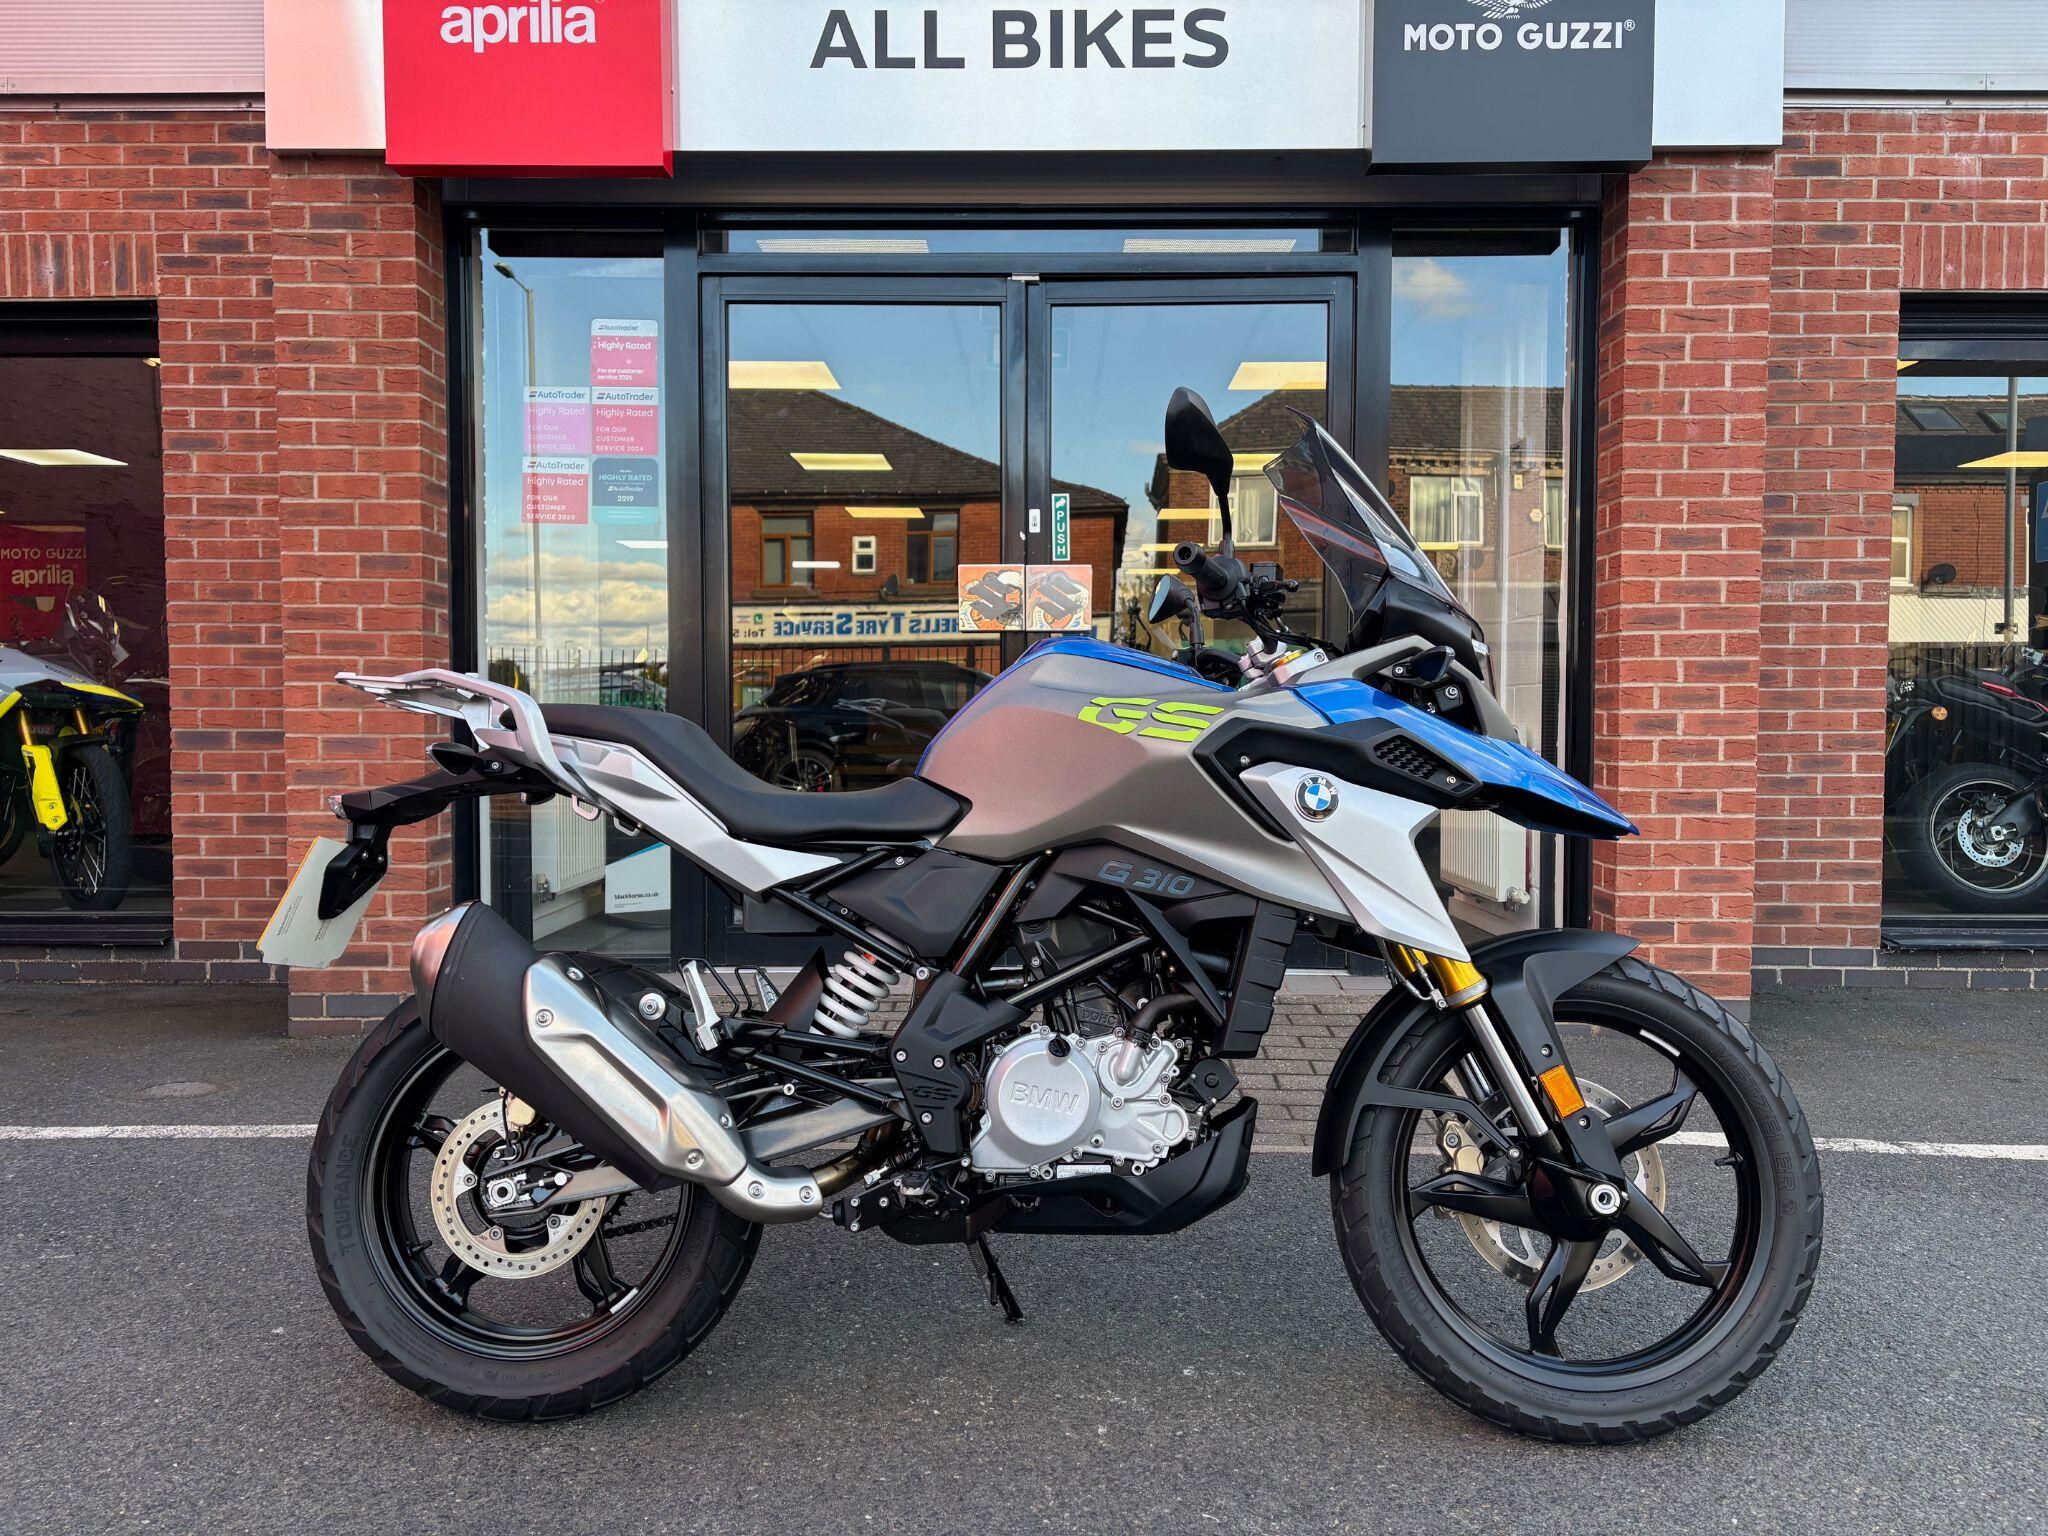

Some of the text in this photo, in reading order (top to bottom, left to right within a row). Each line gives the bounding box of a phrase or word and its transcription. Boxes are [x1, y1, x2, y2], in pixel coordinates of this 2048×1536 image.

[440, 0, 596, 53] aprilia
[810, 8, 1229, 69] ALL BIKES
[1404, 24, 1503, 51] MOTO
[597, 341, 651, 351] Highly Rated
[537, 391, 586, 399] AutoTrader
[606, 392, 654, 401] AutoTrader
[528, 406, 585, 417] Highly Rated
[596, 408, 653, 418] Highly Rated
[536, 461, 585, 470] AutoTrader
[527, 476, 584, 487] Highly Rated
[1056, 510, 1067, 556] PUSH
[0, 548, 41, 559] MOTO
[11, 564, 74, 588] aprilia
[1077, 696, 1225, 742] GS
[1303, 776, 1339, 795] BMW
[1099, 860, 1195, 896] G 310
[1010, 1081, 1080, 1116] BMW
[333, 1133, 360, 1257] TOURANCE
